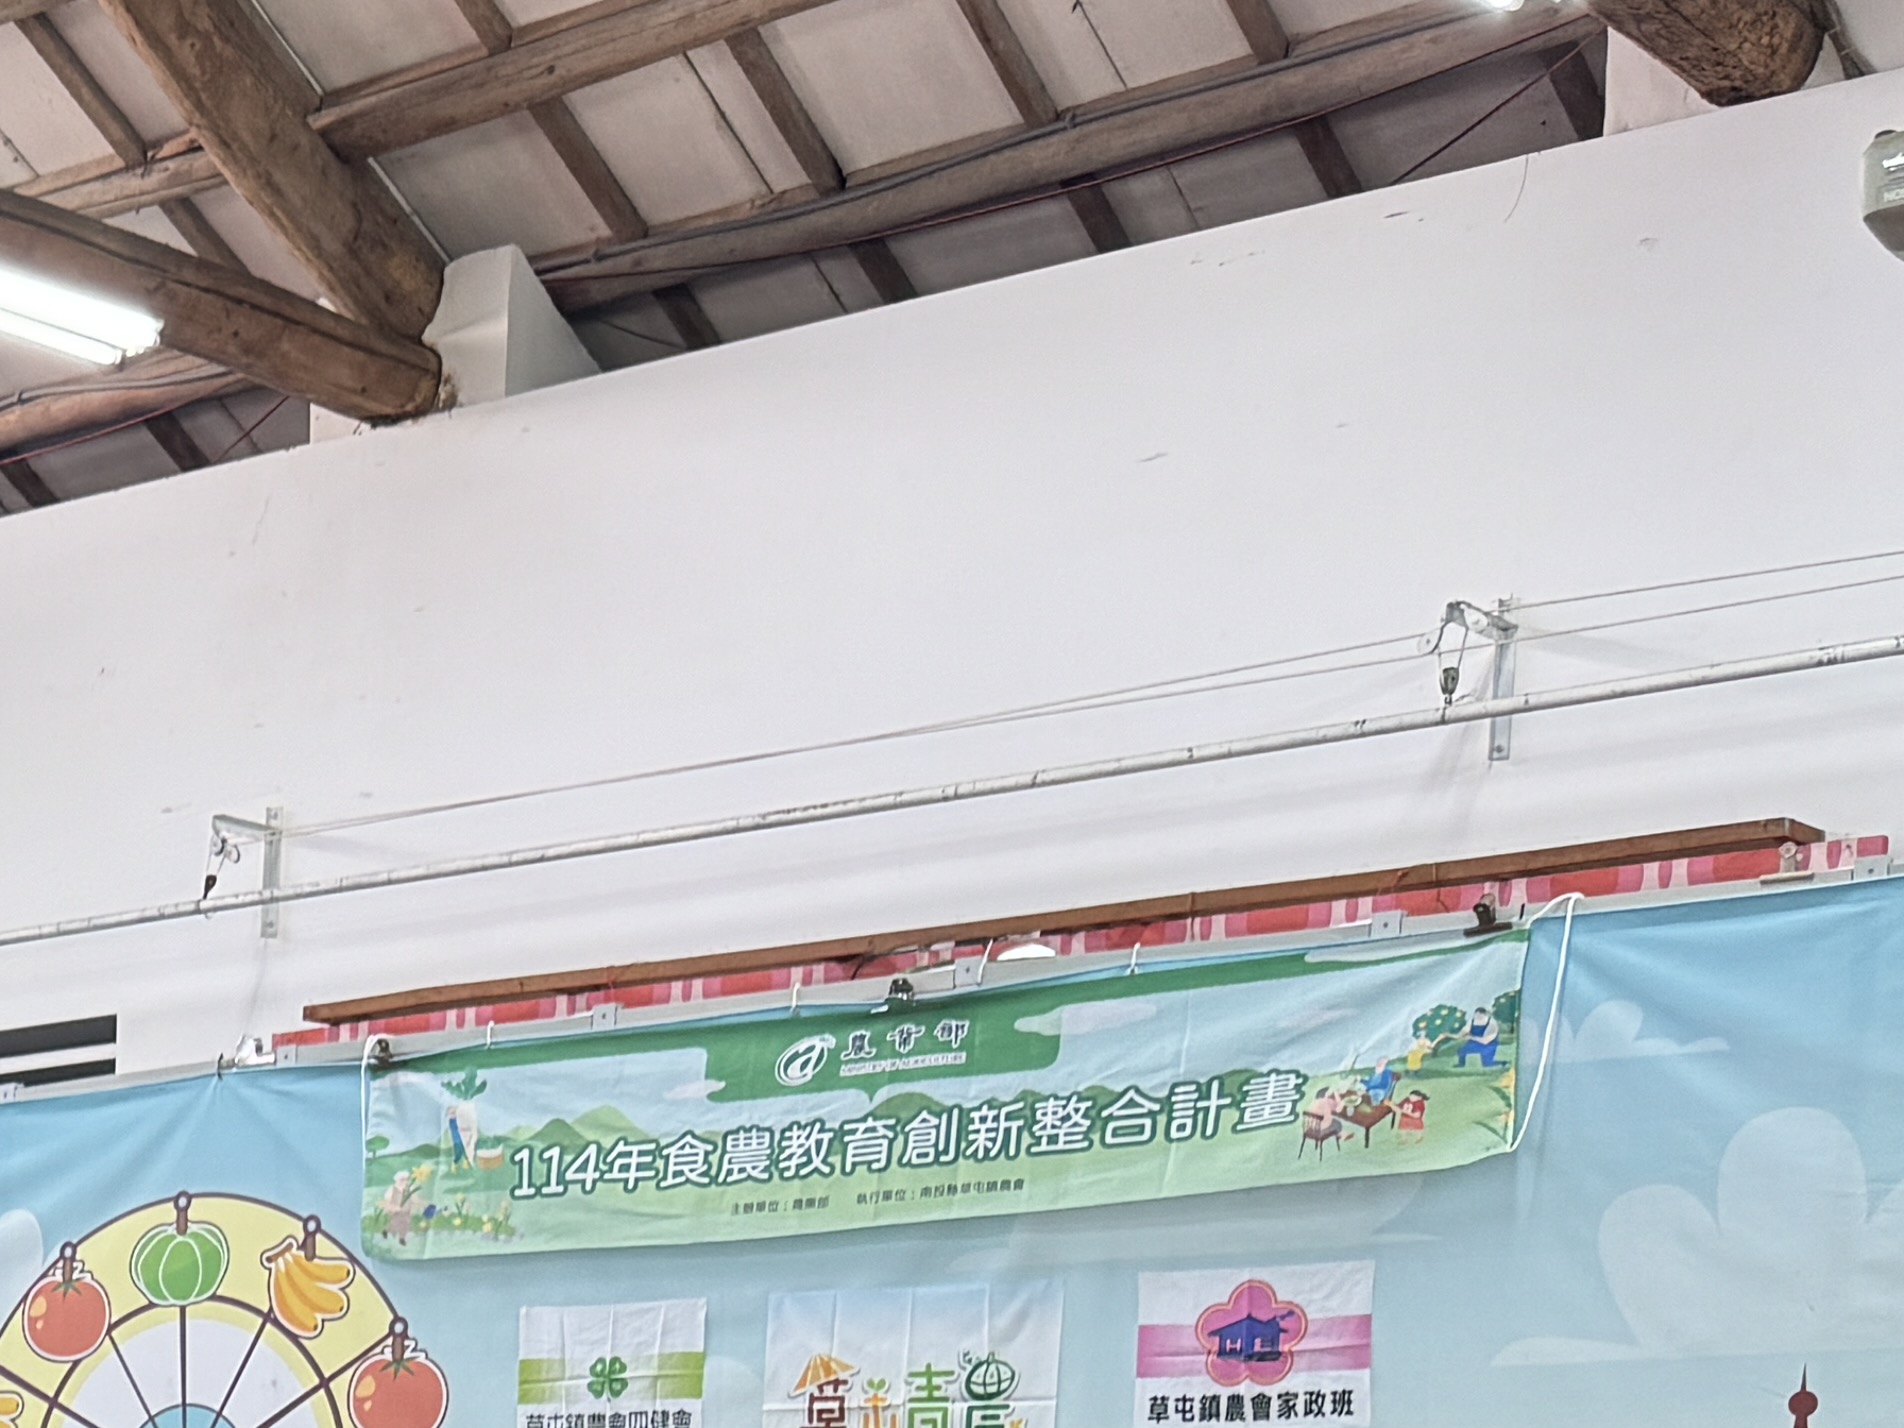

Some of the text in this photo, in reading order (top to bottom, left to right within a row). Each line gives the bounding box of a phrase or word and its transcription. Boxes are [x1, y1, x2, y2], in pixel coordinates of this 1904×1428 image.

[510, 1072, 1306, 1200] 114年食農教育創新整合計畫
[1146, 1388, 1355, 1425] 草屯鎮農會家政班
